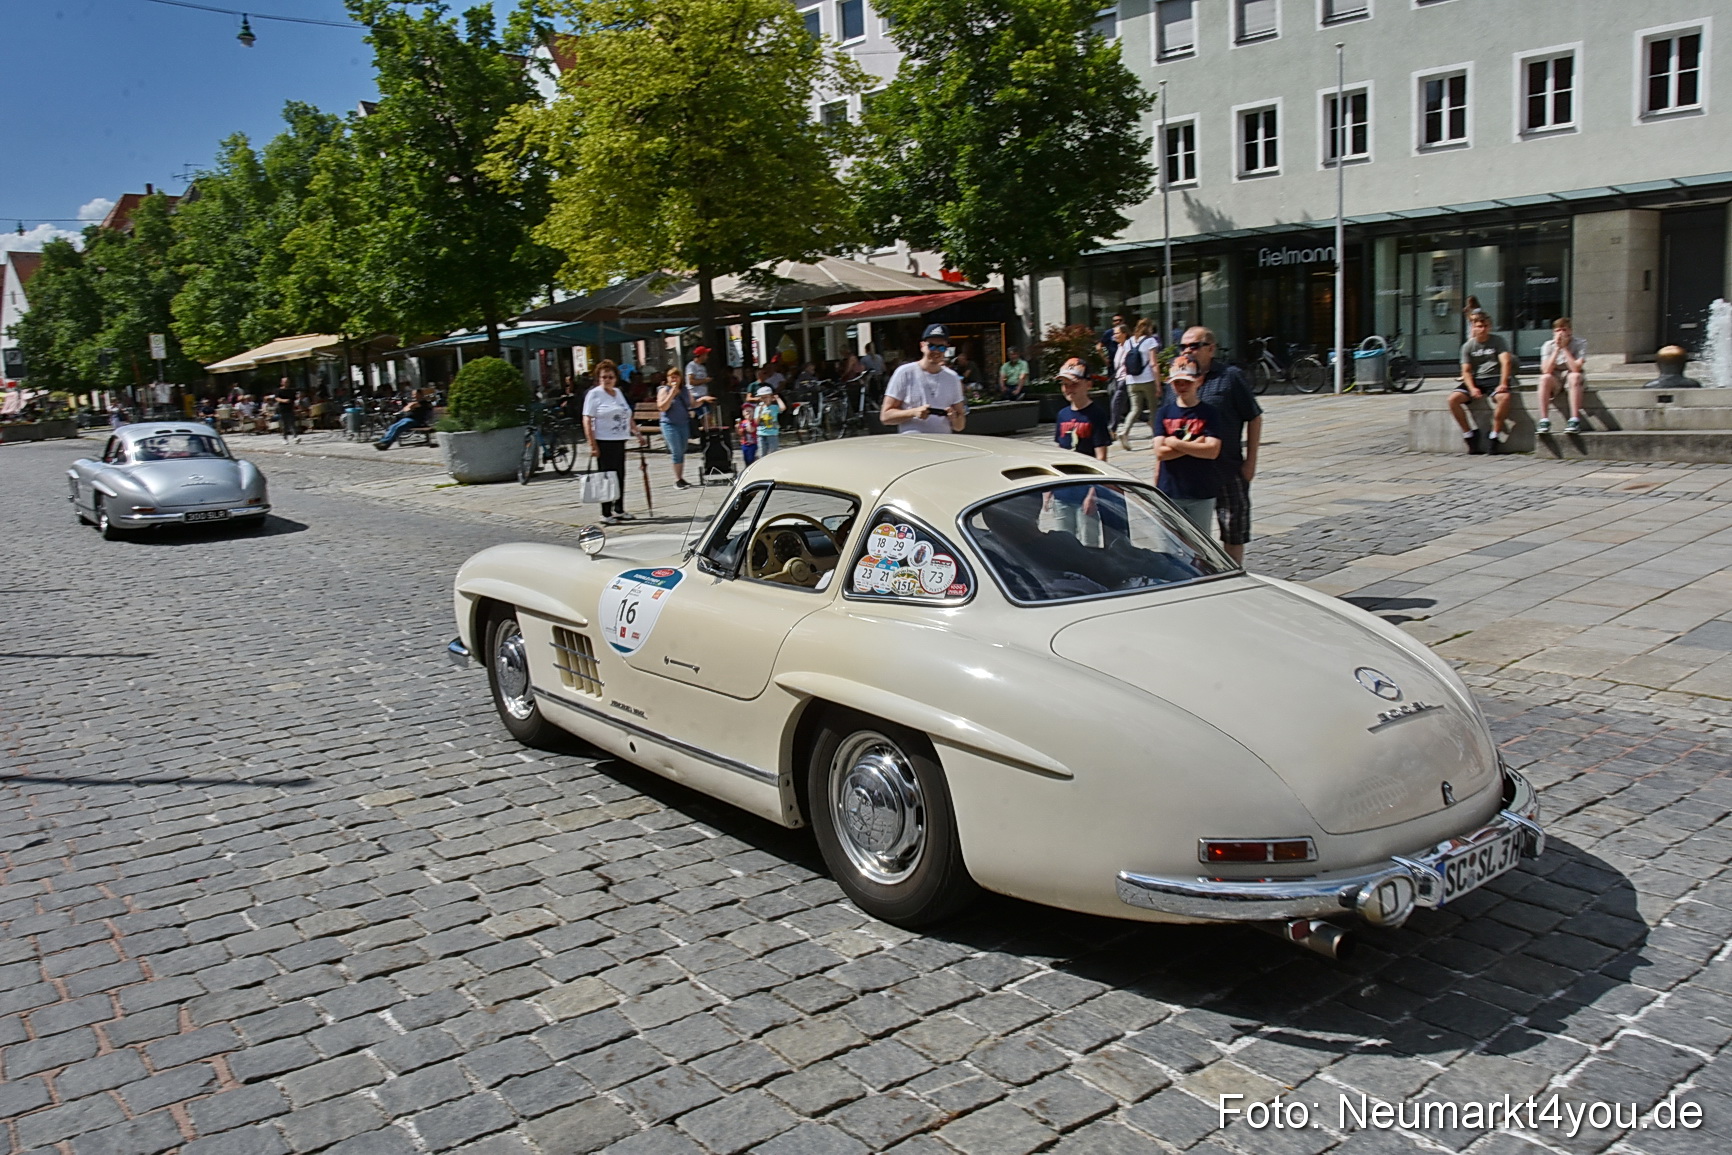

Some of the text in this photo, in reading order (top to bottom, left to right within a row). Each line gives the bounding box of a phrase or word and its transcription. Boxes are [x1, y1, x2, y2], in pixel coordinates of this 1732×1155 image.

[876, 537, 887, 549] 18
[862, 568, 873, 580] 23
[880, 571, 890, 583] 21
[928, 571, 944, 584] 73
[897, 581, 911, 591] 151
[618, 598, 640, 625] 16
[1445, 853, 1468, 897] SC
[1477, 846, 1496, 881] SL
[1378, 881, 1399, 918] D
